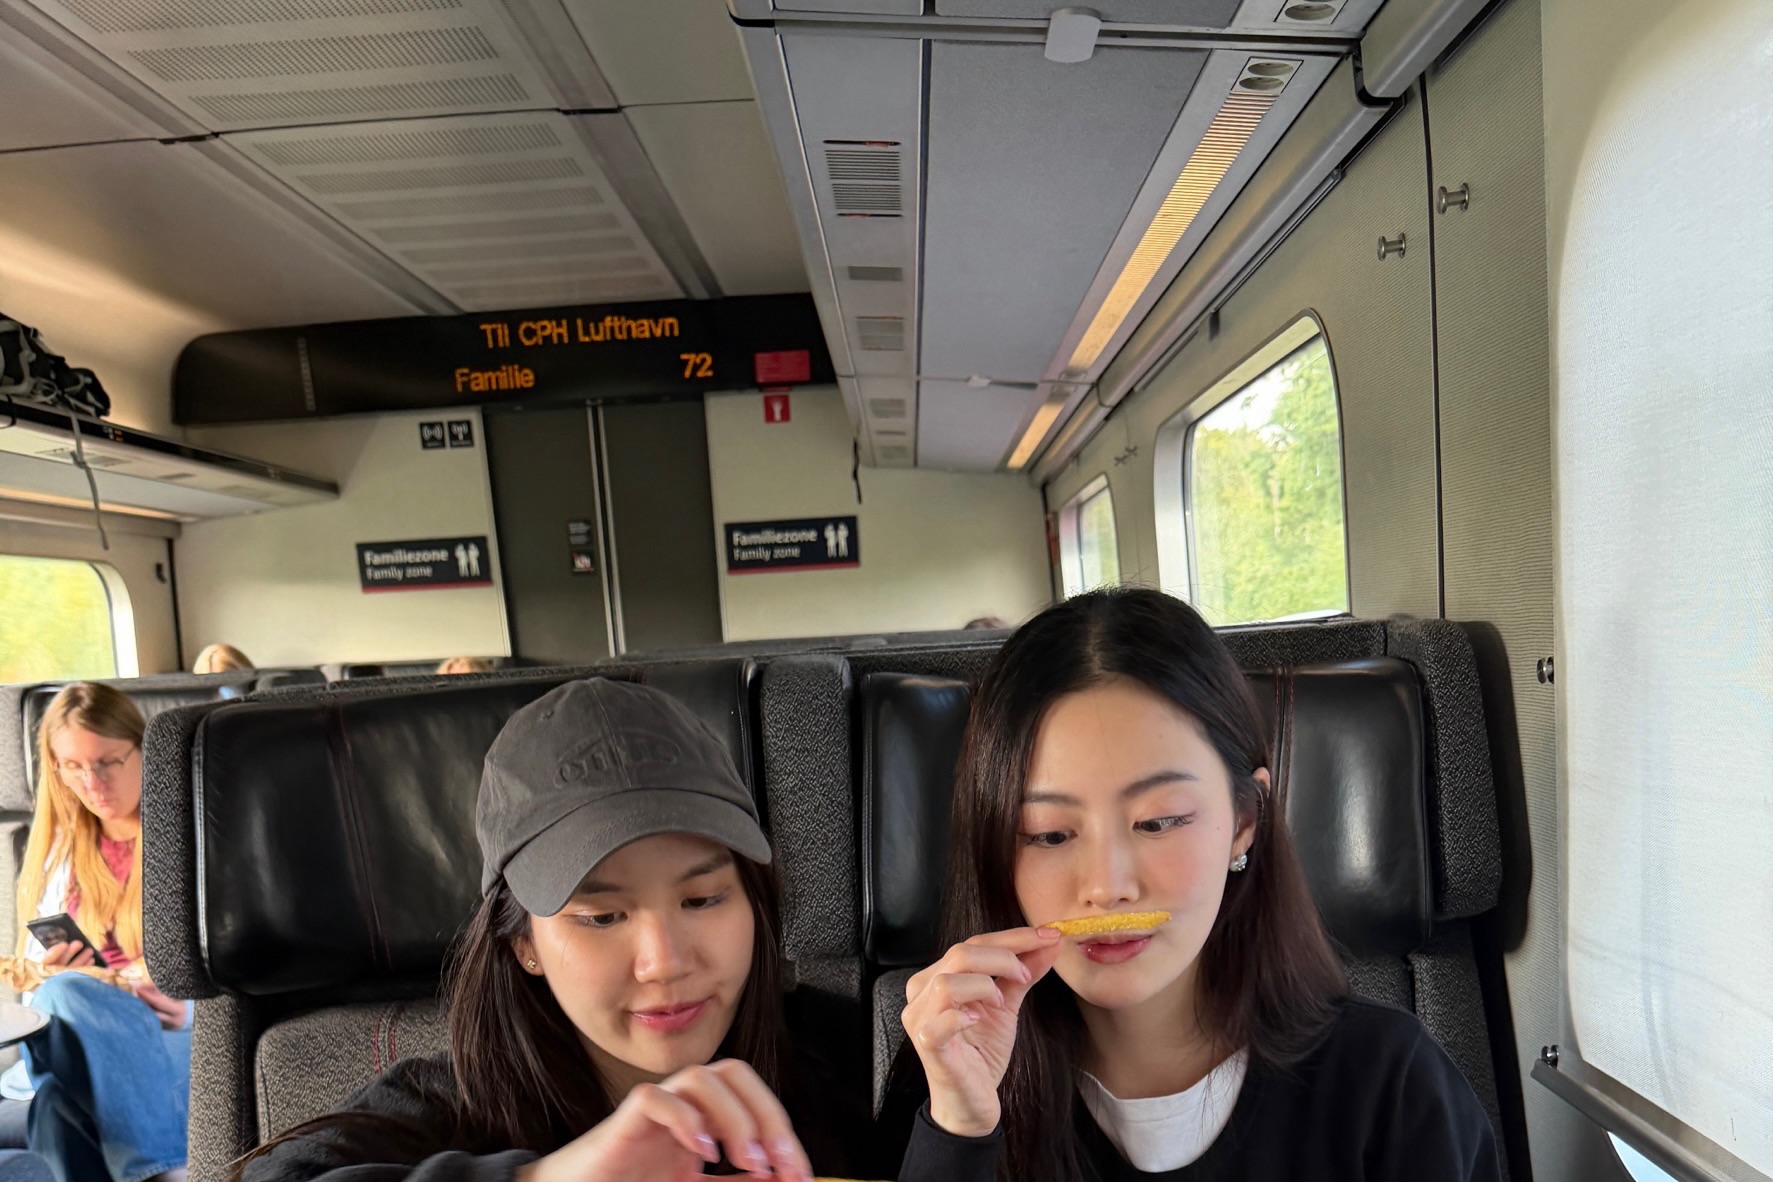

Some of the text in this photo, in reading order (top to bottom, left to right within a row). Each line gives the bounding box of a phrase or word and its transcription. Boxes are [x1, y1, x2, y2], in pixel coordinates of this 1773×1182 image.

[518, 319, 569, 346] CPH
[577, 315, 679, 342] Lufthavn
[680, 353, 714, 378] 72
[455, 365, 535, 392] Familie
[733, 528, 818, 546] Familiezone
[364, 548, 449, 566] Familiezone
[733, 546, 800, 562] Family zone
[366, 566, 433, 581] Family zone
